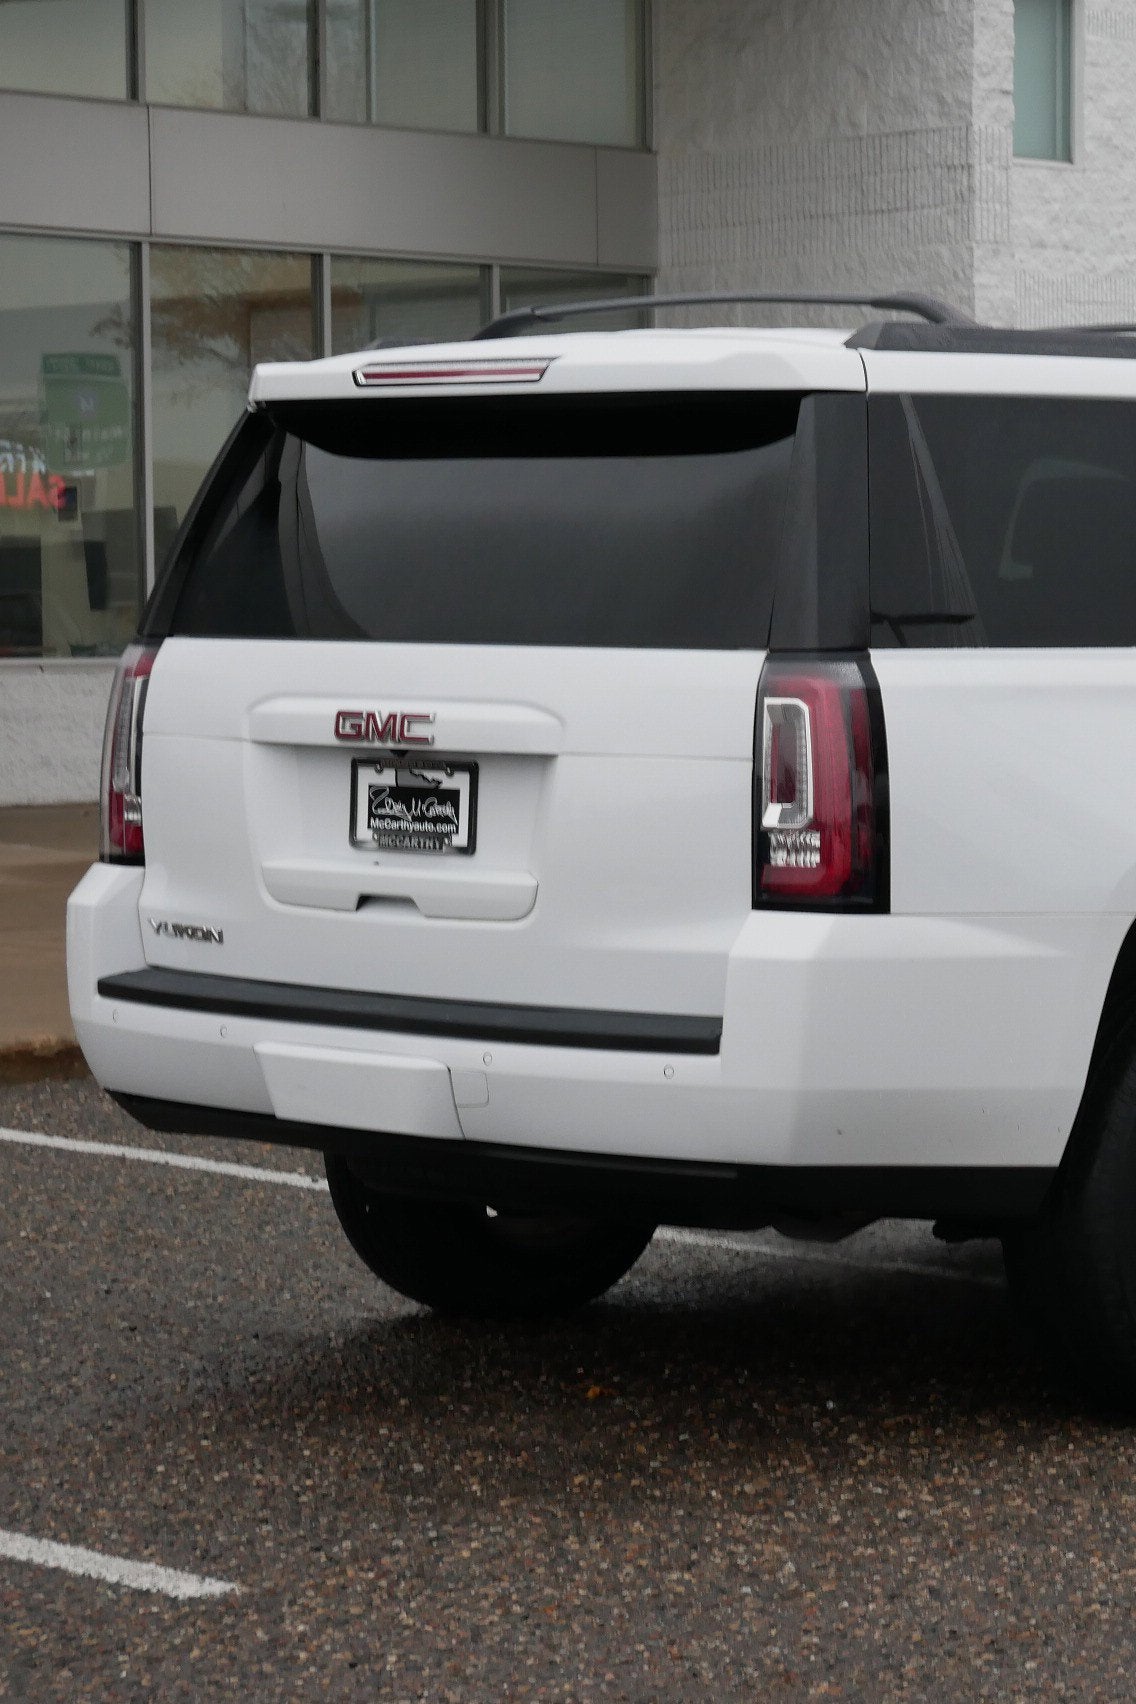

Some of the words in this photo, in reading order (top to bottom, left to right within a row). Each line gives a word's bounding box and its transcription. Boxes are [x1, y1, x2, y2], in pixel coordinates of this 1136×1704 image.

[334, 710, 435, 745] GMC
[370, 816, 458, 834] McCarthyauto.com
[147, 917, 224, 946] YUKON
